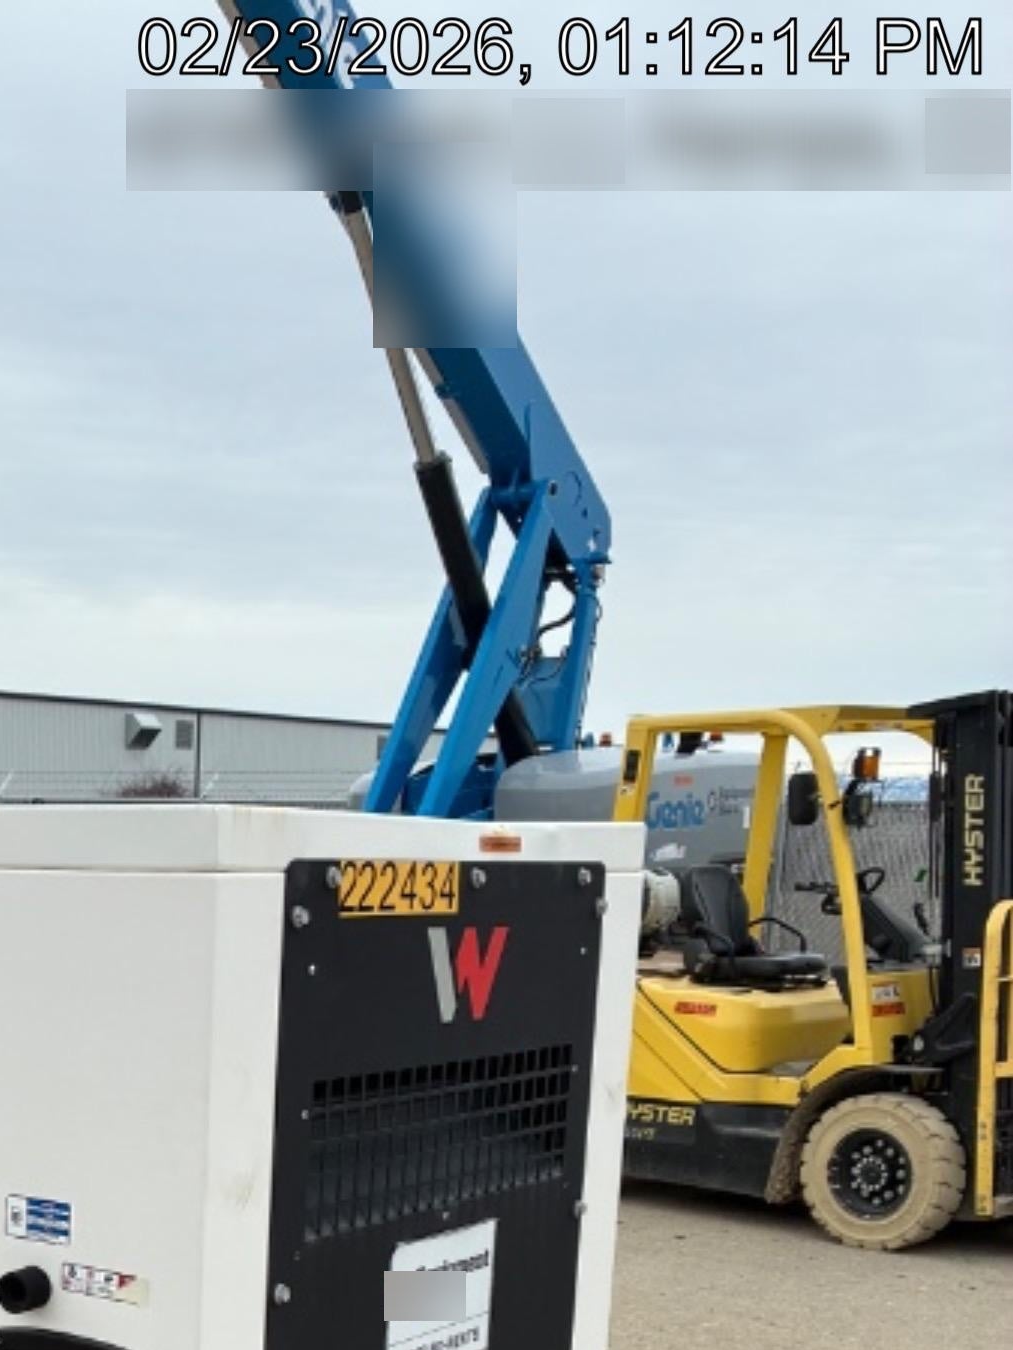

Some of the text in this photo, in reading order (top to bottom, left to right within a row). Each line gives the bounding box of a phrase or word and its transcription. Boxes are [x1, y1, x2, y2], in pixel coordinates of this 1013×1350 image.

[963, 773, 985, 887] HYSTER
[339, 859, 456, 913] 222434
[629, 1103, 697, 1127] YSTER
